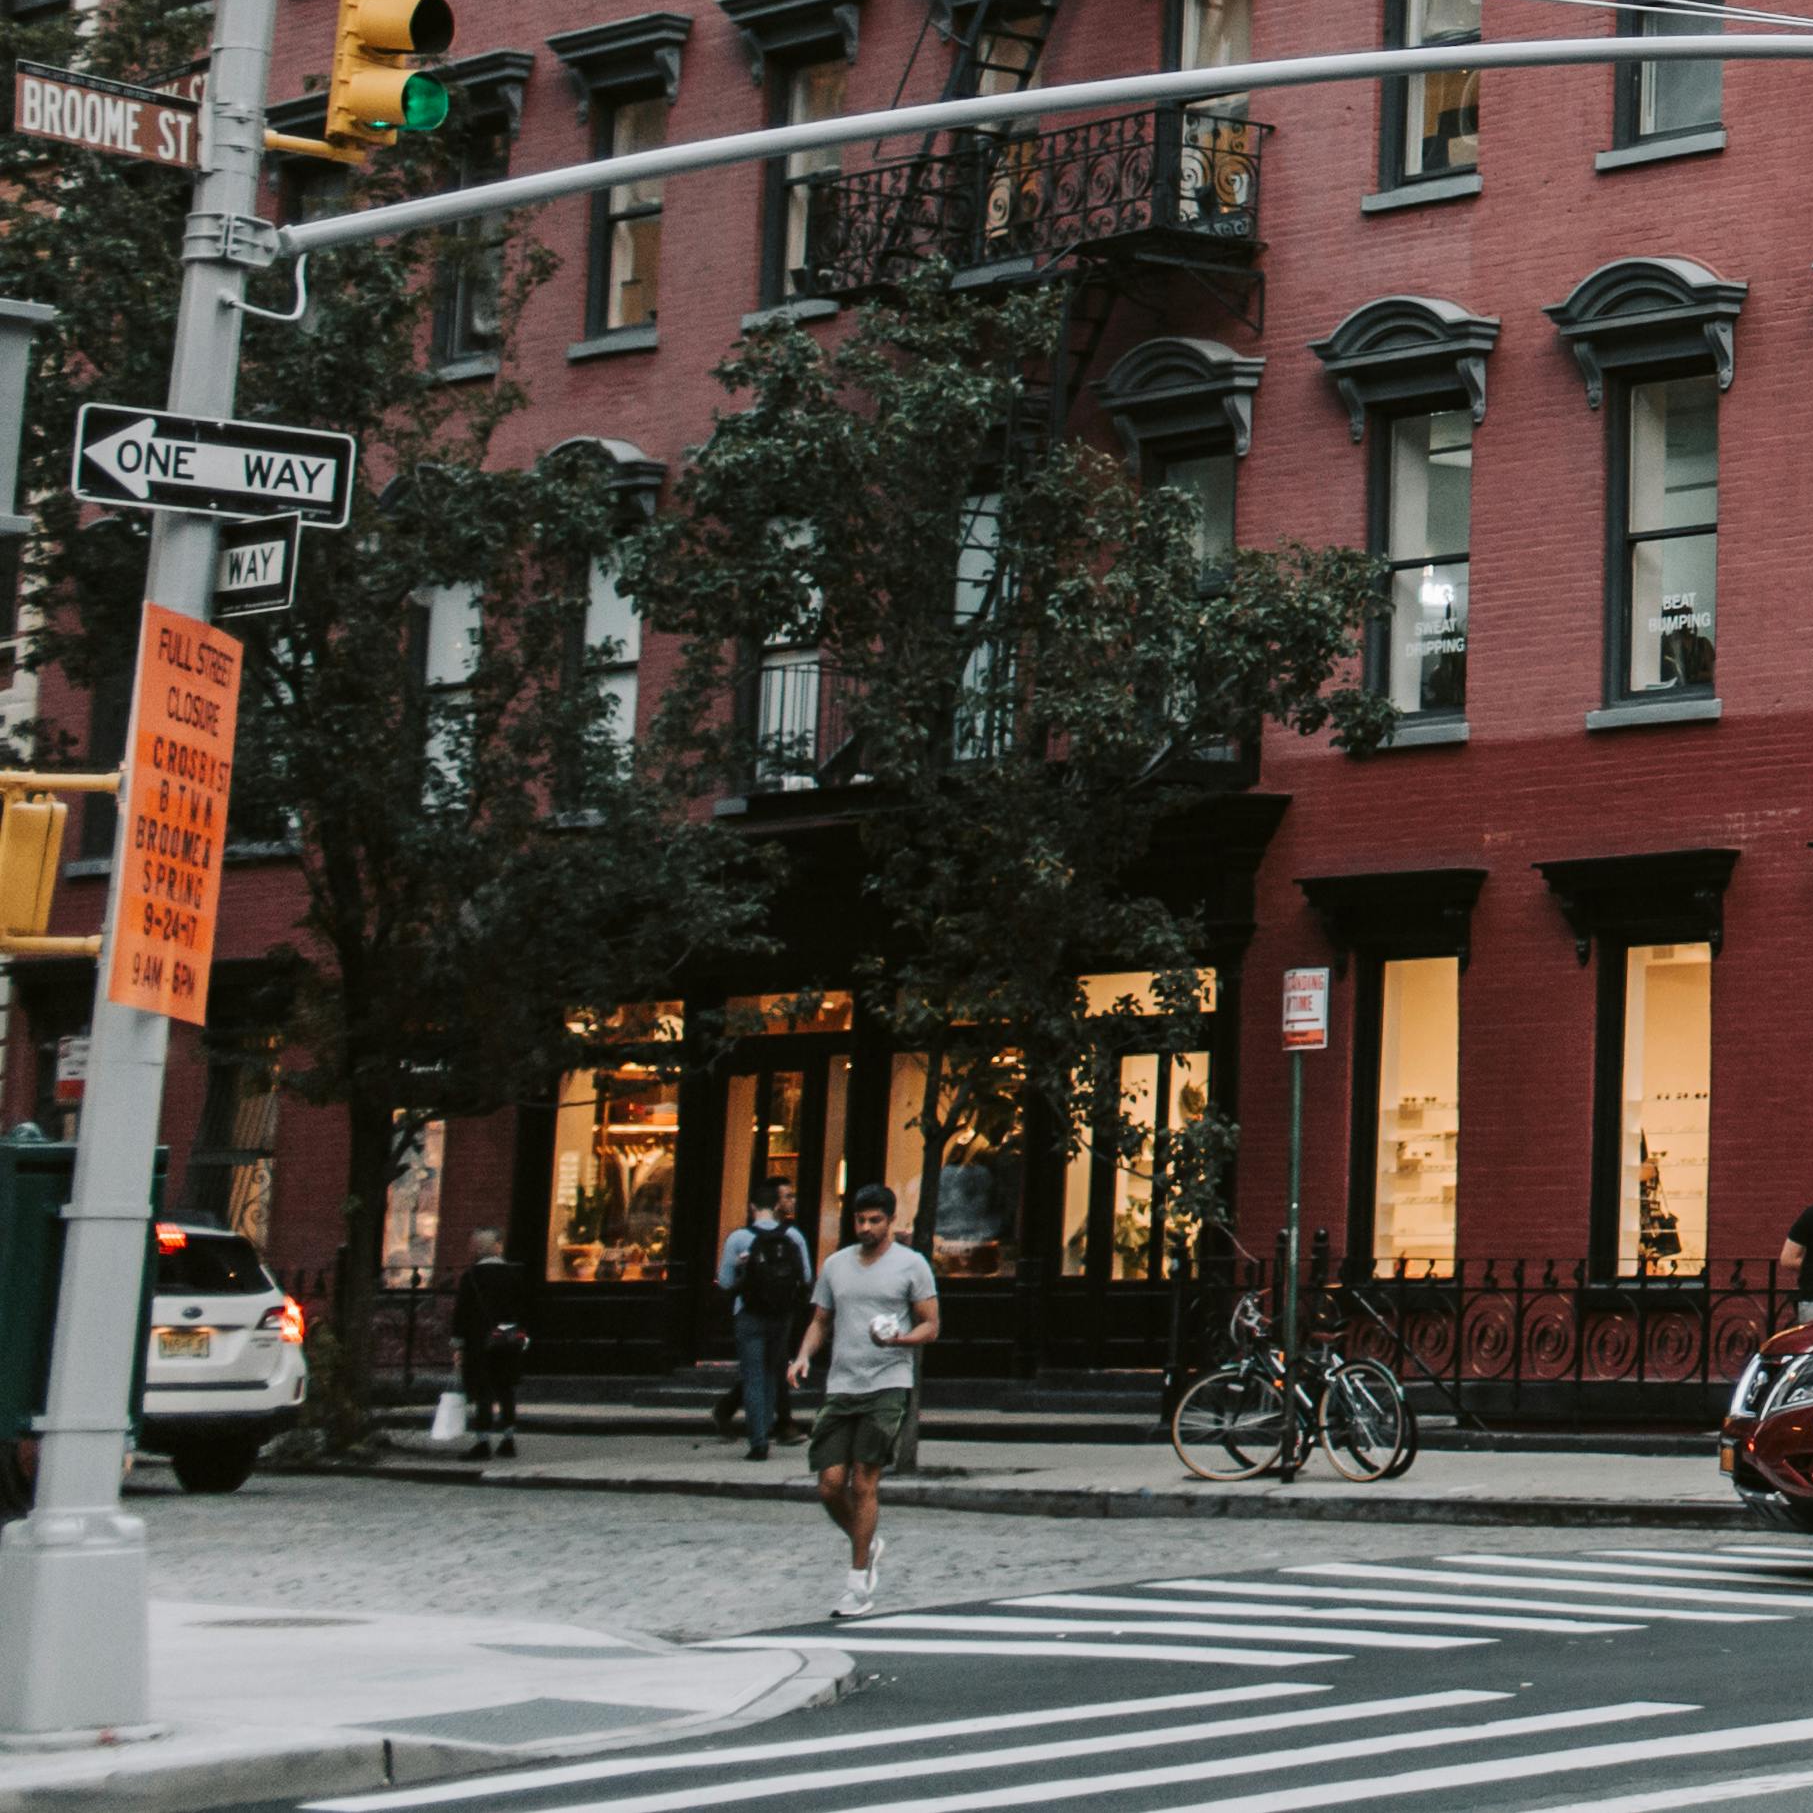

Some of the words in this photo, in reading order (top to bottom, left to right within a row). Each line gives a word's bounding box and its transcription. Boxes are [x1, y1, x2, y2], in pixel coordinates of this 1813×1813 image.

[23, 78, 142, 154] BROOME
[158, 110, 192, 163] ST
[117, 439, 197, 480] ONE
[244, 453, 326, 494] WAY
[228, 546, 275, 586] WAY
[1648, 612, 1711, 633] BUMPING
[1662, 592, 1697, 611] BEAT
[1406, 637, 1465, 658] DRIPPING
[1415, 617, 1457, 636] SWEAT
[158, 627, 193, 672] FULL
[197, 642, 234, 688] STREET
[167, 686, 220, 737] CLOSURE
[143, 860, 203, 910] SPRING
[143, 902, 197, 950] 9-24-17
